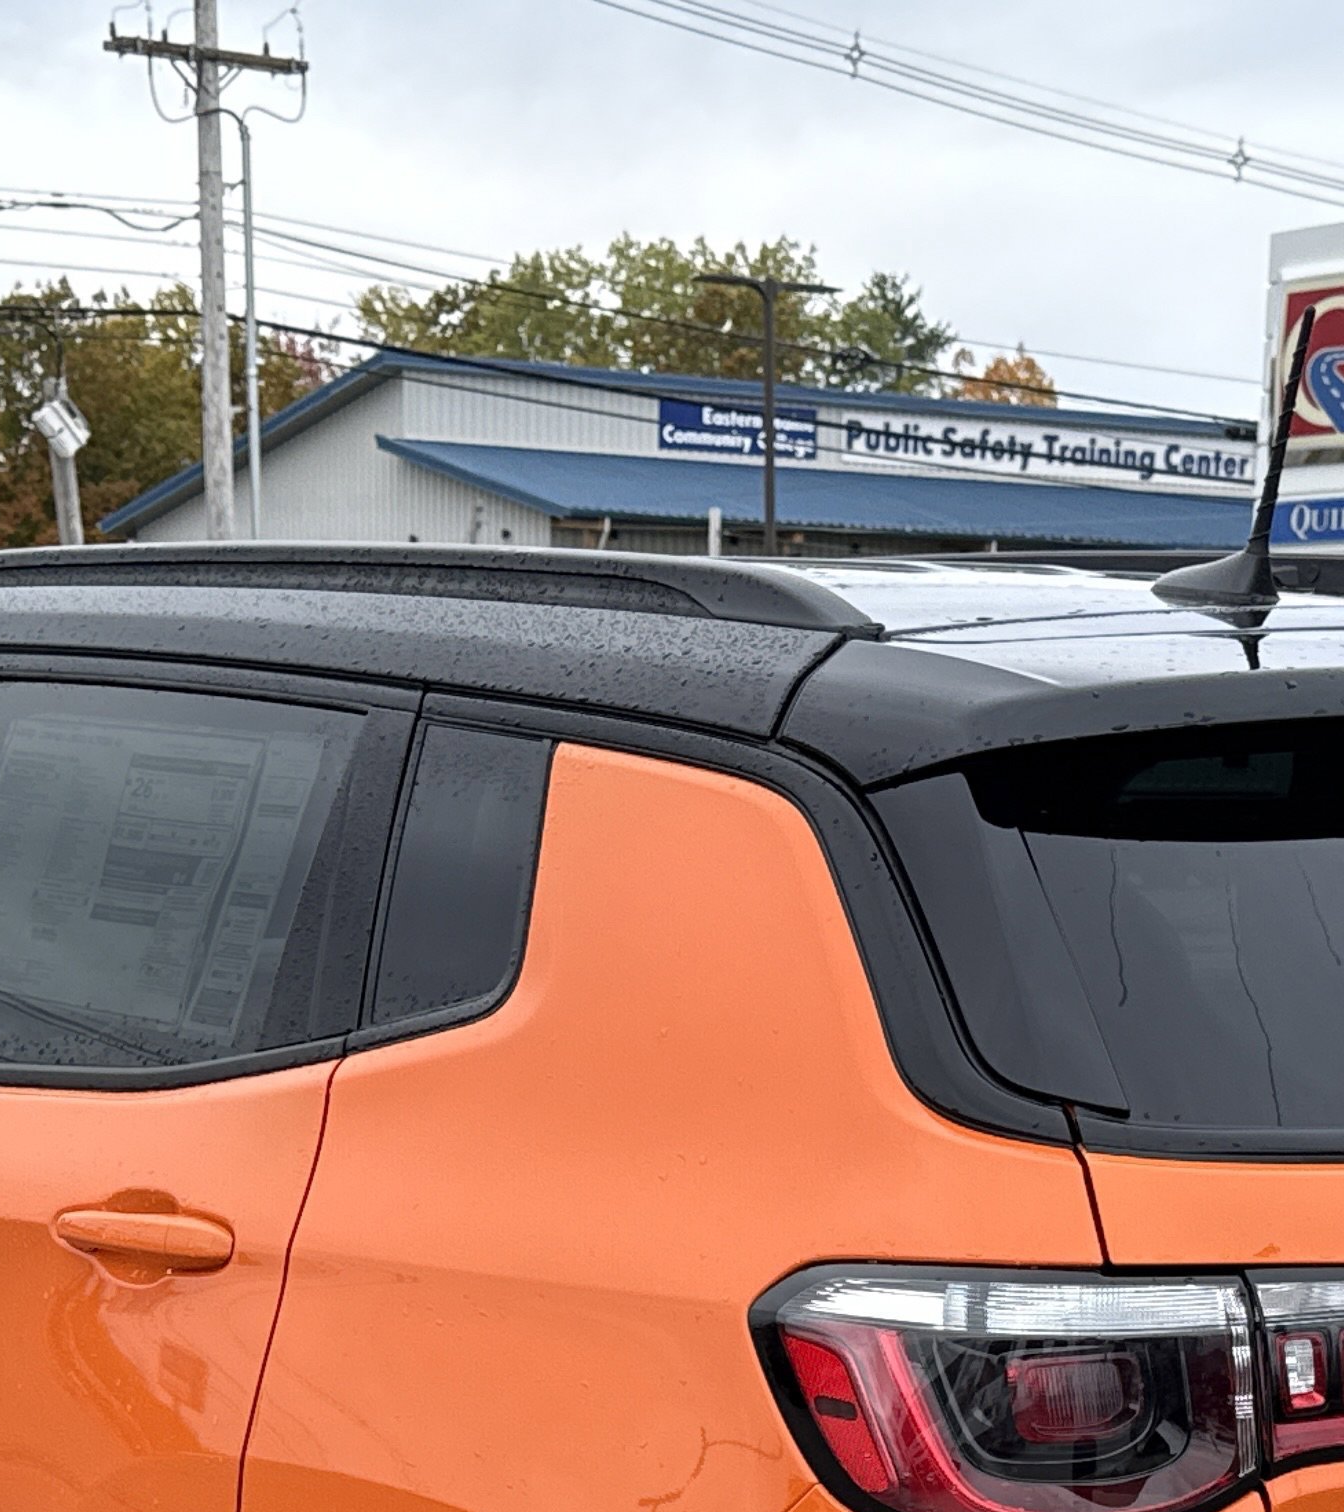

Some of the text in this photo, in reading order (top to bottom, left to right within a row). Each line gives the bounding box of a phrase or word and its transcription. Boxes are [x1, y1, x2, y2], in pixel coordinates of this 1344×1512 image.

[702, 407, 764, 429] Eastern
[662, 424, 752, 453] Community
[847, 419, 1249, 480] Public Safety Training Center
